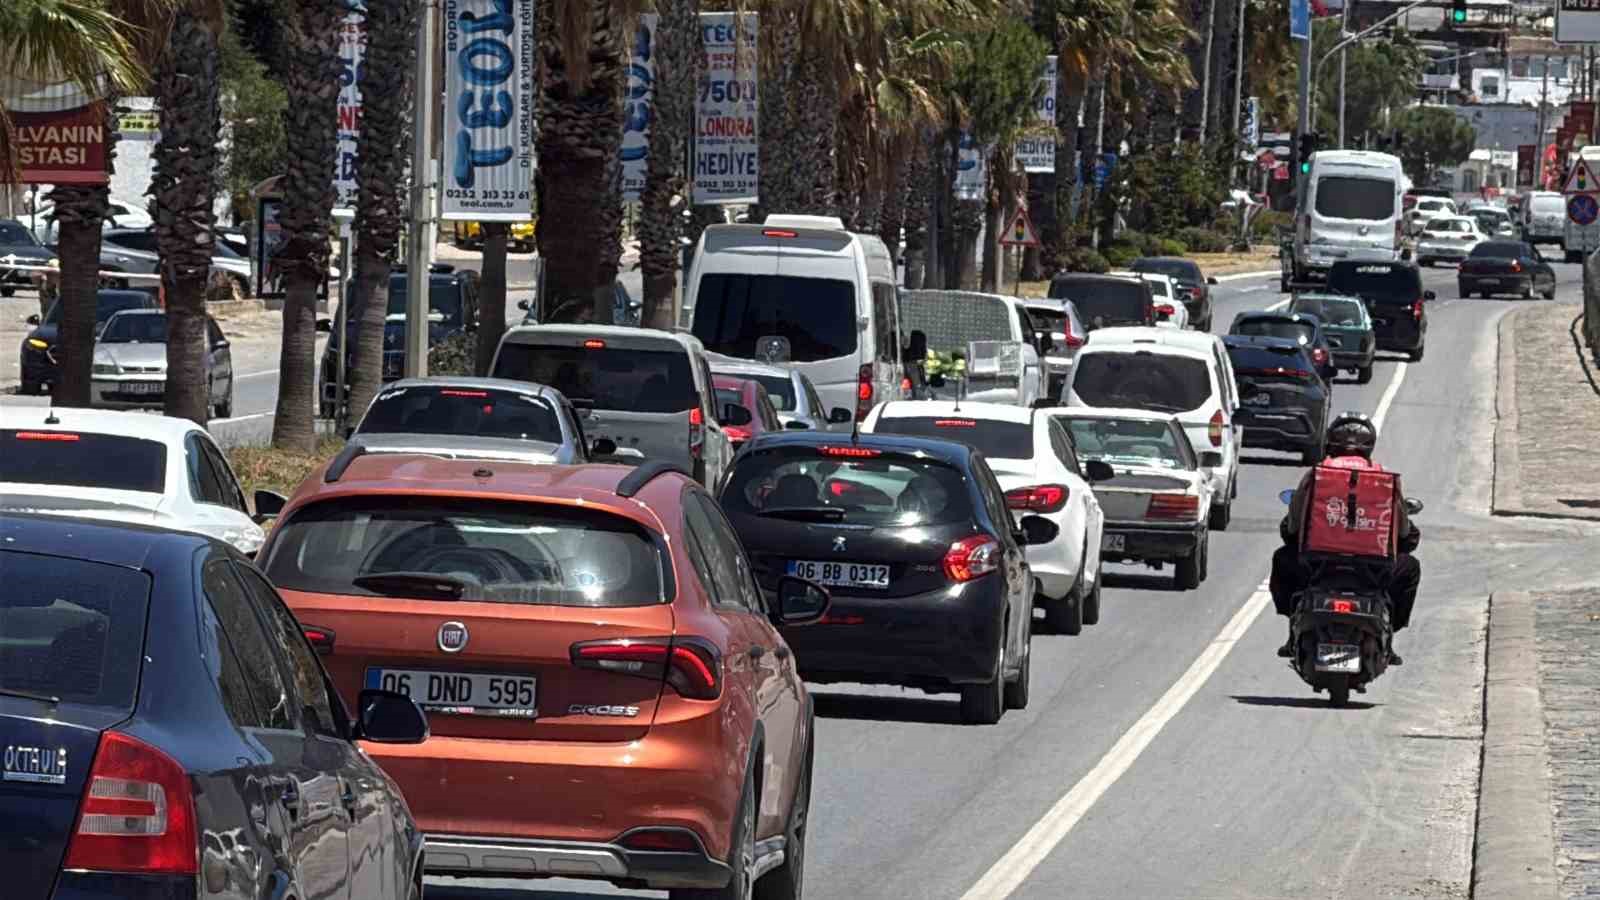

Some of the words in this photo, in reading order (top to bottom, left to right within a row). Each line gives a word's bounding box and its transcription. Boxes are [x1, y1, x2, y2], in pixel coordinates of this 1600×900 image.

[520, 93, 531, 148] KURSLARI
[699, 116, 754, 136] LONDRA
[17, 146, 86, 164] STASI
[697, 145, 756, 175] HEDİYE
[446, 189, 476, 199] 0252
[482, 190, 499, 199] 313
[502, 190, 515, 199] 33
[460, 200, 514, 208] teol.com.tr
[797, 562, 816, 579] 06
[822, 563, 843, 580] BB
[849, 565, 887, 584] 0312
[444, 629, 462, 646] FIAT
[382, 673, 412, 697] 06
[427, 674, 473, 703] DND
[487, 678, 534, 706] 595
[568, 703, 640, 716] CROSS
